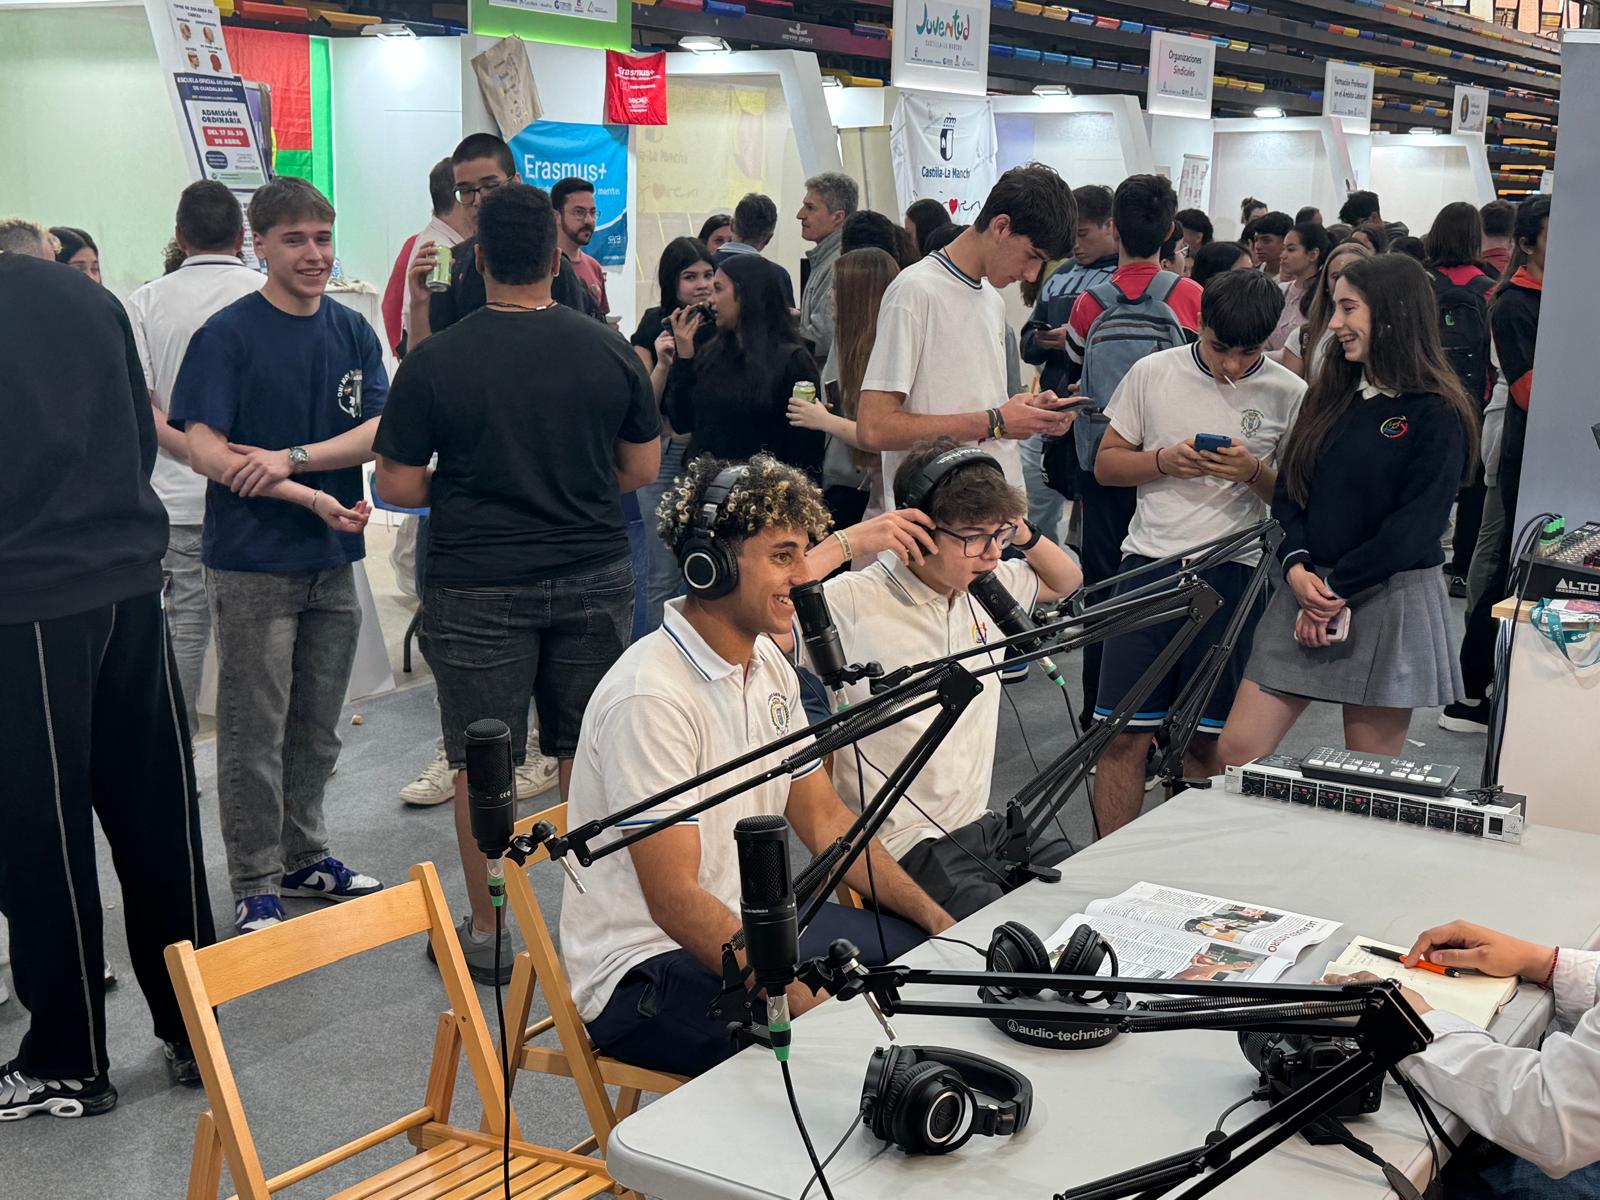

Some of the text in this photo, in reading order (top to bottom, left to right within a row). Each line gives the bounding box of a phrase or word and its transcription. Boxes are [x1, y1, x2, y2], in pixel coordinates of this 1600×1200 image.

[916, 2, 970, 41] Juventud
[202, 108, 238, 116] ADMISIÓN
[524, 154, 607, 182] Erasmus+
[1019, 1025, 1110, 1041] audio-technica
